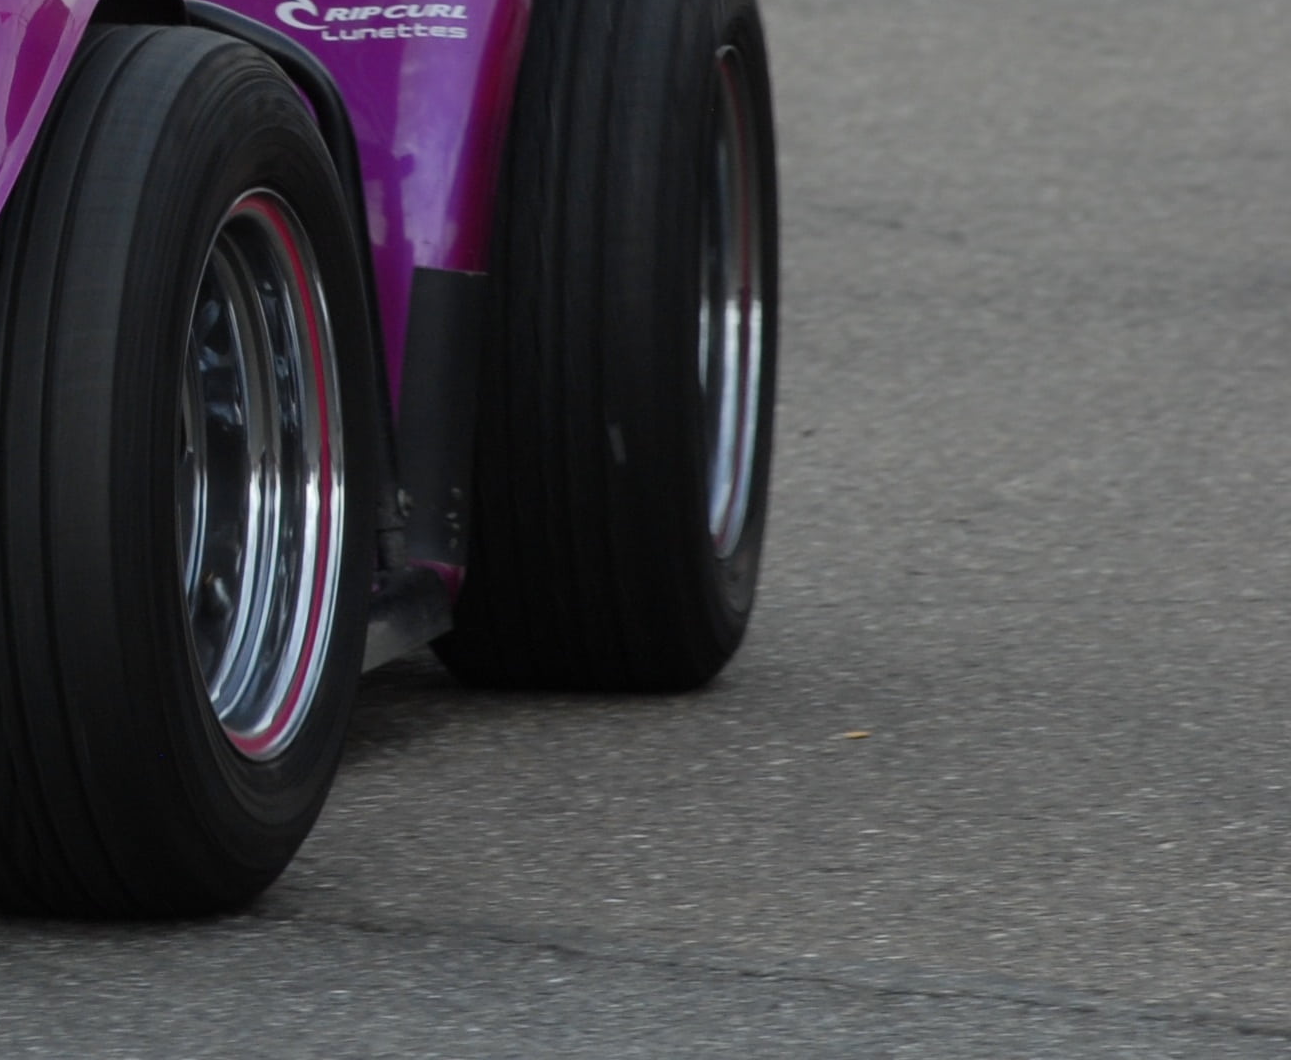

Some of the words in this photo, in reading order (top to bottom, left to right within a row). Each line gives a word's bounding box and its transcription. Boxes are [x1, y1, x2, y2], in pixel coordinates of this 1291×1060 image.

[323, 6, 383, 22] RIP
[383, 3, 468, 20] CURL
[321, 23, 468, 41] Lunettes
